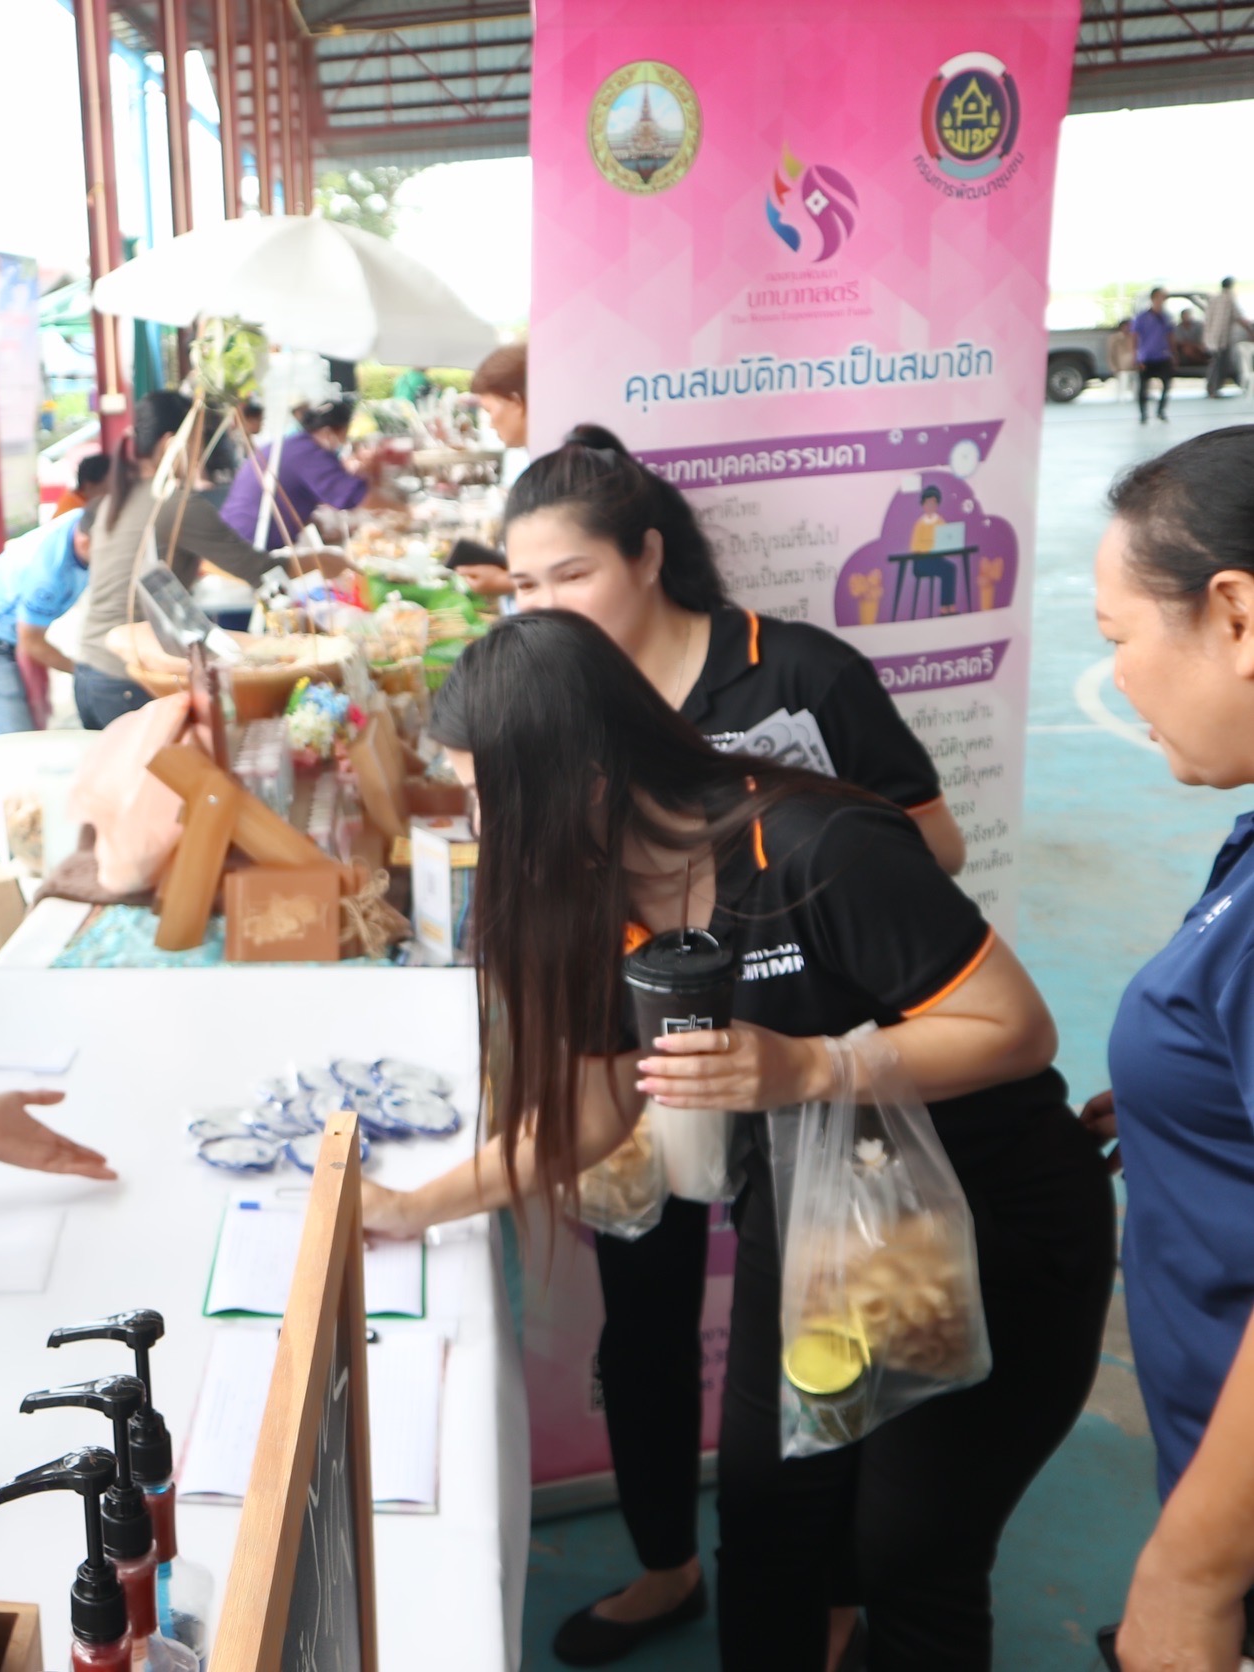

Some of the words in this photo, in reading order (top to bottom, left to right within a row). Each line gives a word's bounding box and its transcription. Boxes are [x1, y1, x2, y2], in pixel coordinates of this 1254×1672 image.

[624, 343, 994, 412] คุณสมบัติการเป็นสมาชิก
[638, 443, 866, 485] ระเภทบุคคลธรรมดา
